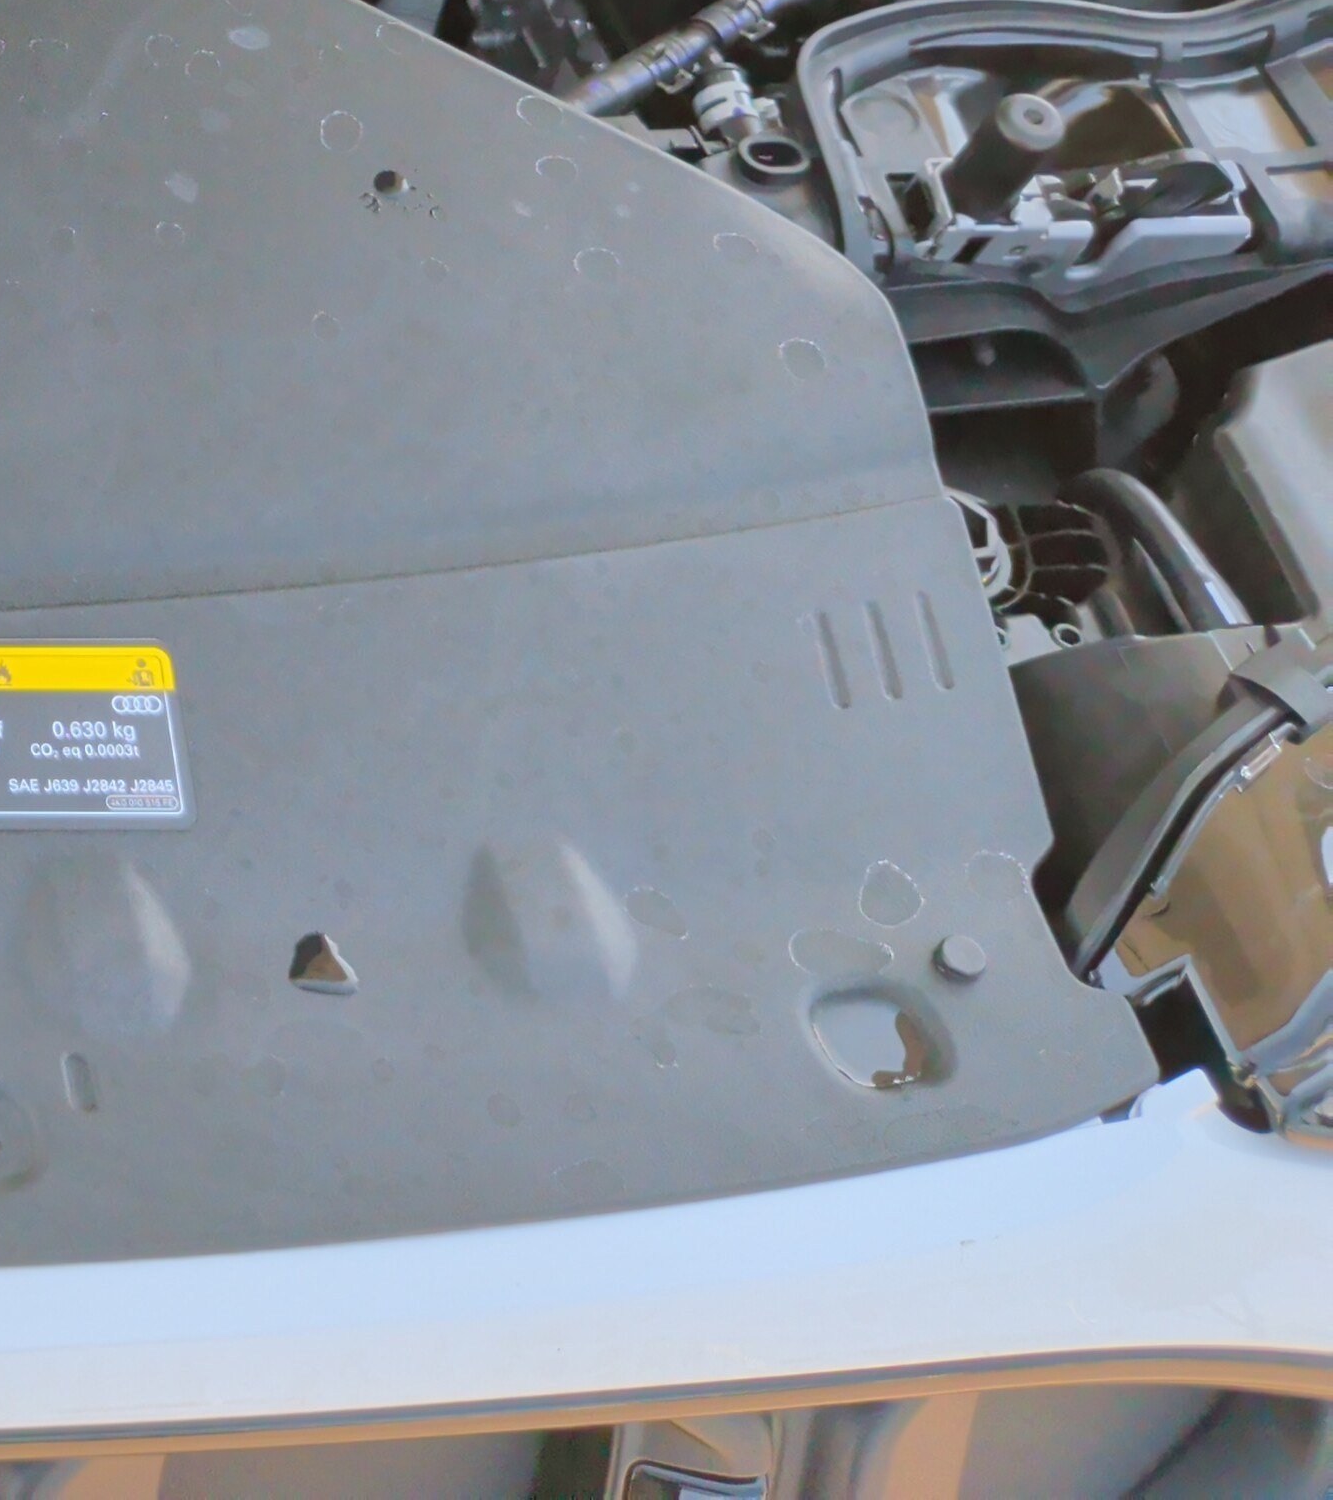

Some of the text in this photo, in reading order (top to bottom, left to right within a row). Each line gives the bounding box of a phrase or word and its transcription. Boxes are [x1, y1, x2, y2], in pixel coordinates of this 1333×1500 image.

[52, 720, 136, 742] 0.630 kg
[62, 747, 81, 759] eq
[84, 744, 139, 757] 0.0003t
[8, 779, 173, 793] SAE J639 J2842 J2845
